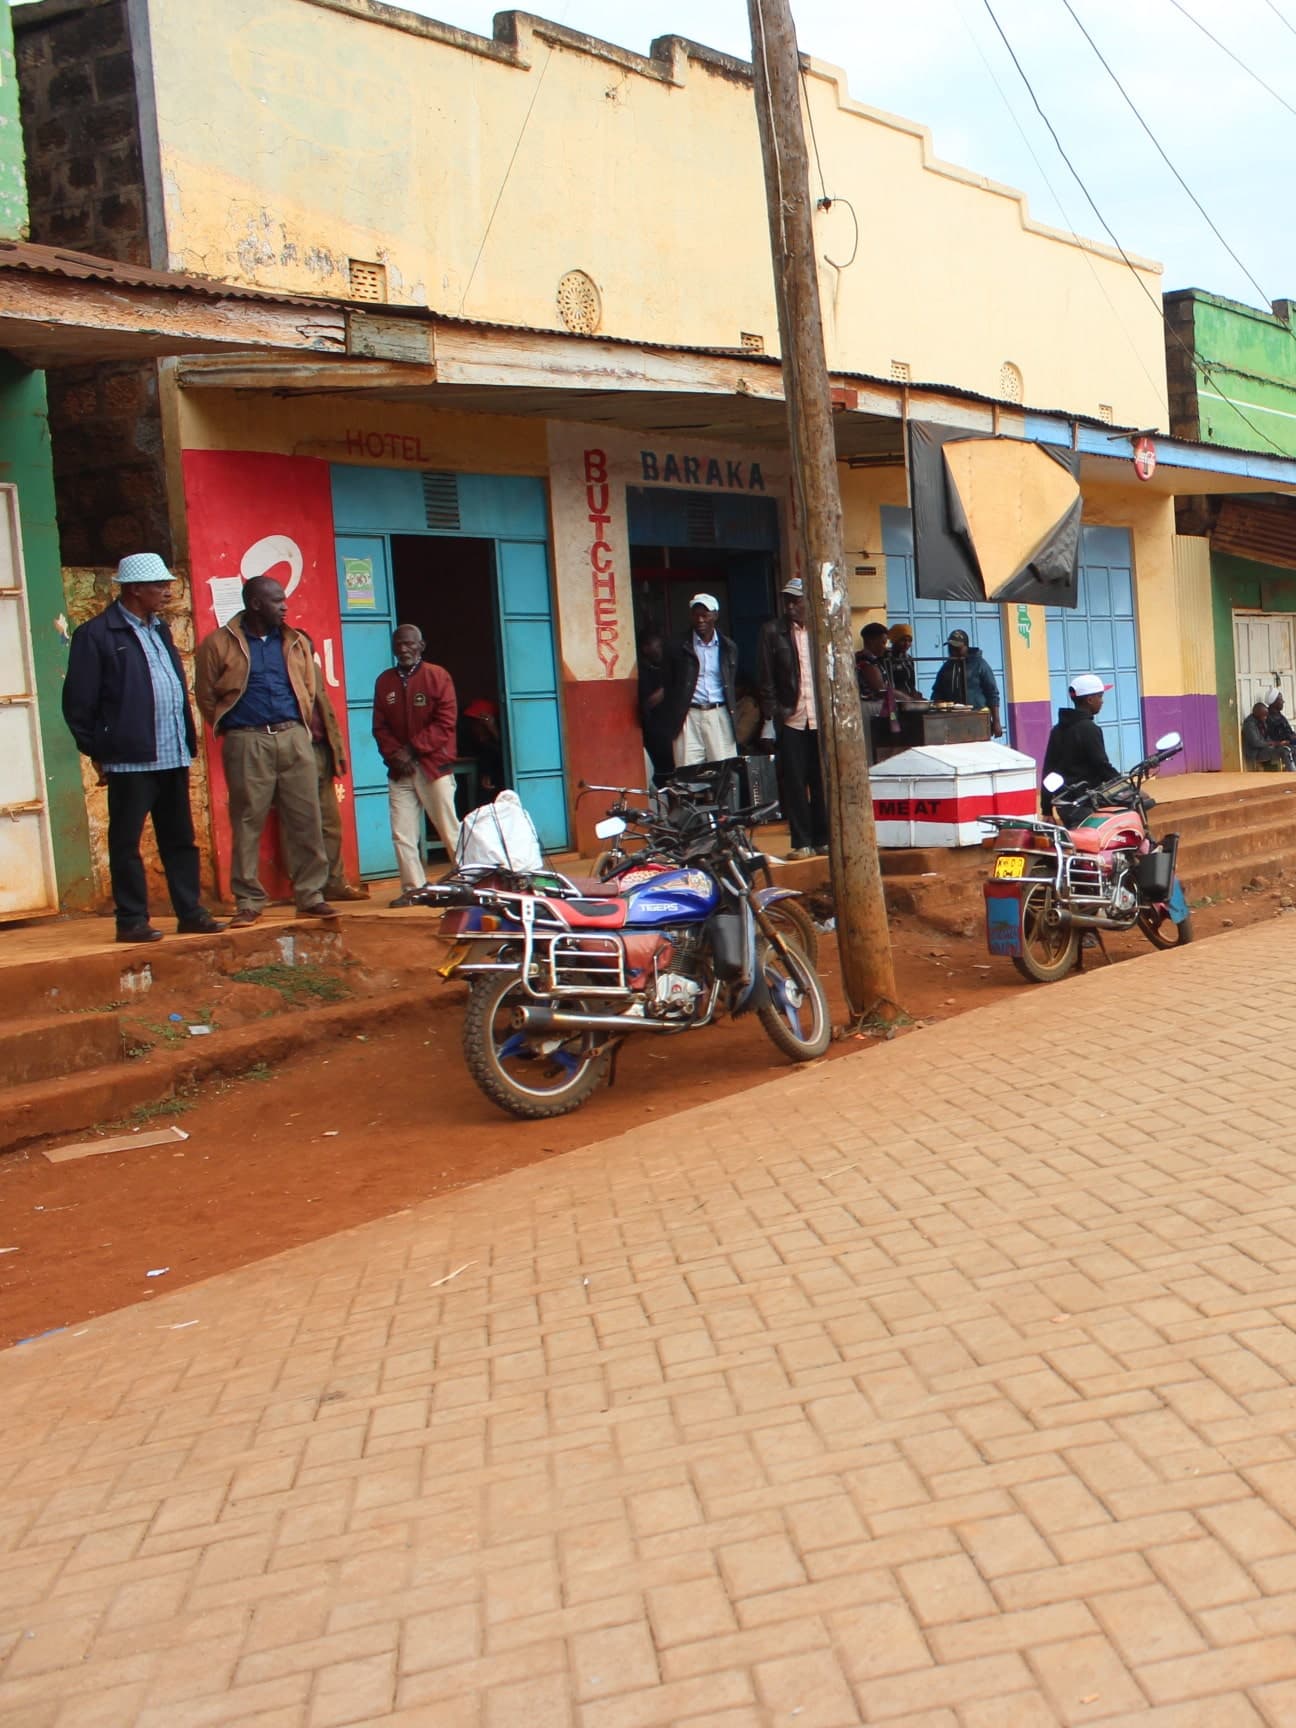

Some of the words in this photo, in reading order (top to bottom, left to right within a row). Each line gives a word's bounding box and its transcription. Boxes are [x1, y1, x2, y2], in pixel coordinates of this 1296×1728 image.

[345, 430, 430, 462] HOTEL
[640, 451, 765, 491] BARAKA
[584, 449, 619, 679] BUTCHERY
[879, 801, 941, 816] MEAT
